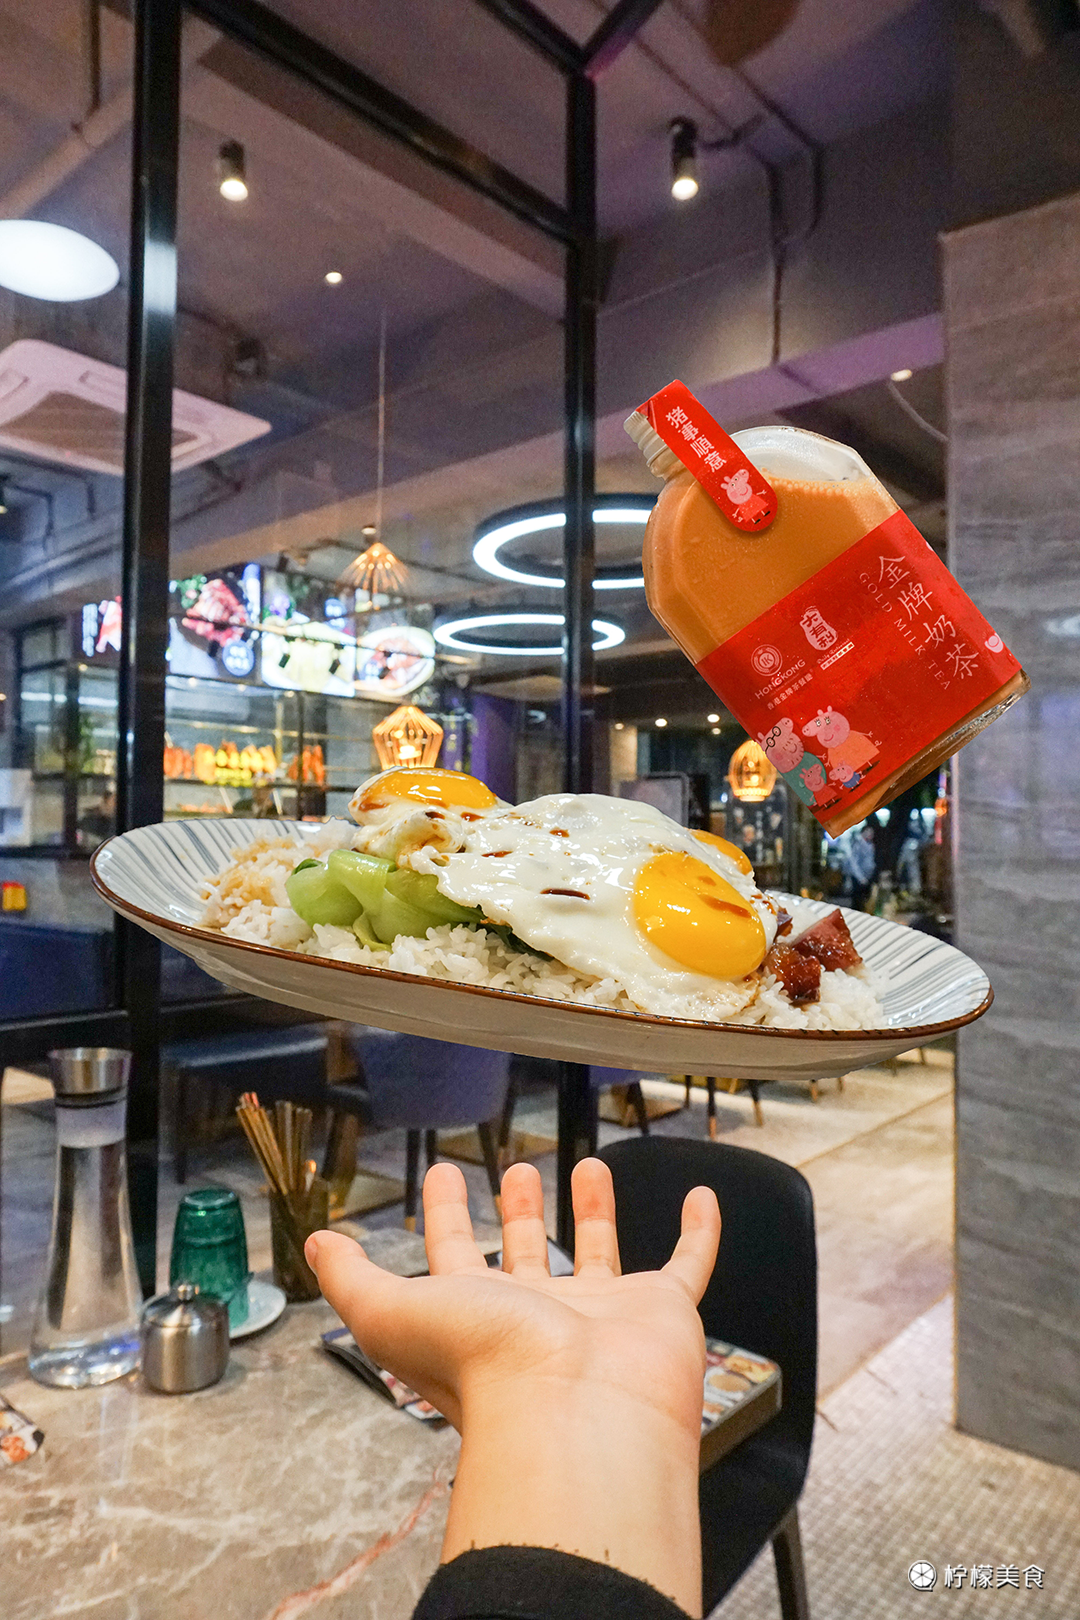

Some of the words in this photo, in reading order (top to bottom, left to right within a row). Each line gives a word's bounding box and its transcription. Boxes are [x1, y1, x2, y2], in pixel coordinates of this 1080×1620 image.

[665, 406, 727, 473] 猪事順意
[859, 572, 893, 613] GOLD
[894, 618, 926, 656] MILK
[928, 660, 951, 690] TEA
[878, 555, 979, 680] 金牌奶茶
[754, 659, 806, 699] HONGKONG
